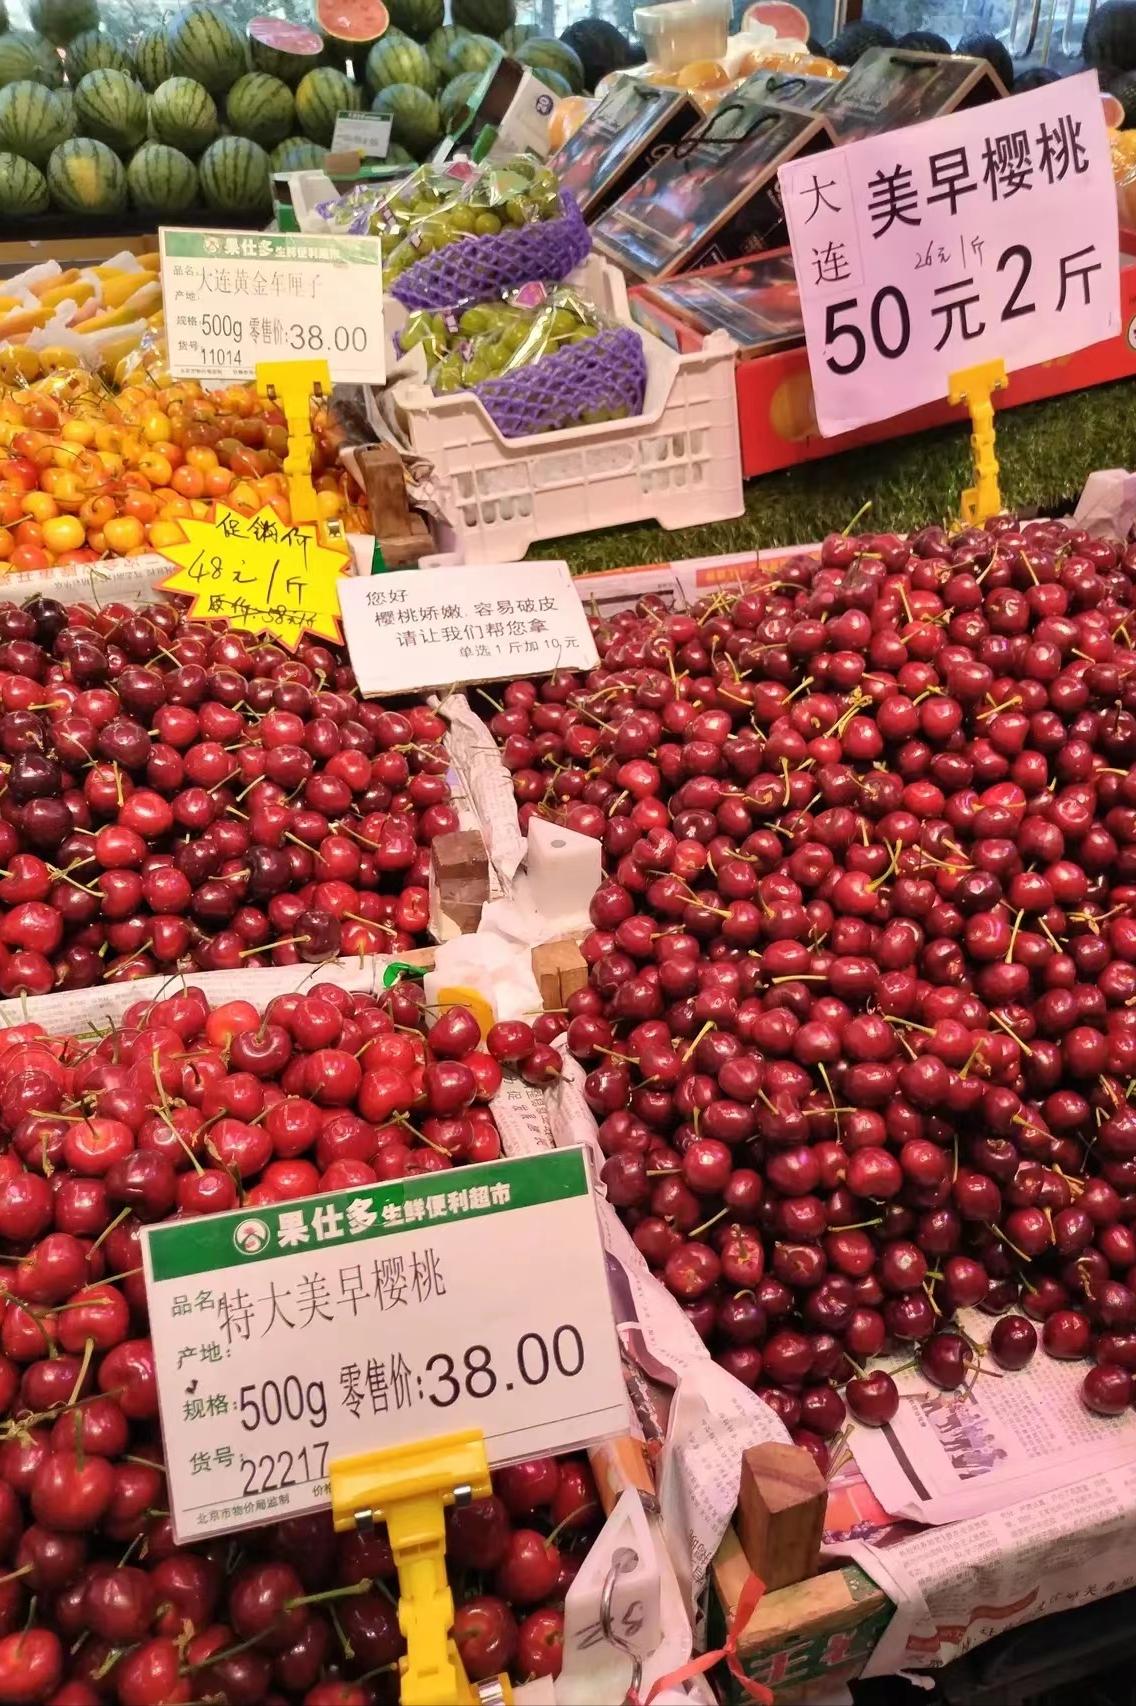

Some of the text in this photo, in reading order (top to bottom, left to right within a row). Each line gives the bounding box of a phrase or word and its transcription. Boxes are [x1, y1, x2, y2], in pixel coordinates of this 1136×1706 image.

[868, 115, 1090, 239] 美早樱桃
[224, 238, 275, 257] 果仕多
[800, 174, 850, 285] 大连
[201, 313, 243, 343] 500g
[289, 323, 368, 352] 38.00
[201, 349, 242, 366] 11014
[366, 589, 408, 606] 您好
[396, 617, 550, 648] 请让我们帮您拿
[277, 1181, 511, 1248] 果仕多 生鲜便利超市
[217, 1247, 447, 1344] 特大美早樱桃
[240, 1375, 328, 1431] 500g
[425, 1324, 585, 1408] 38.00
[240, 1441, 330, 1497] 22217
